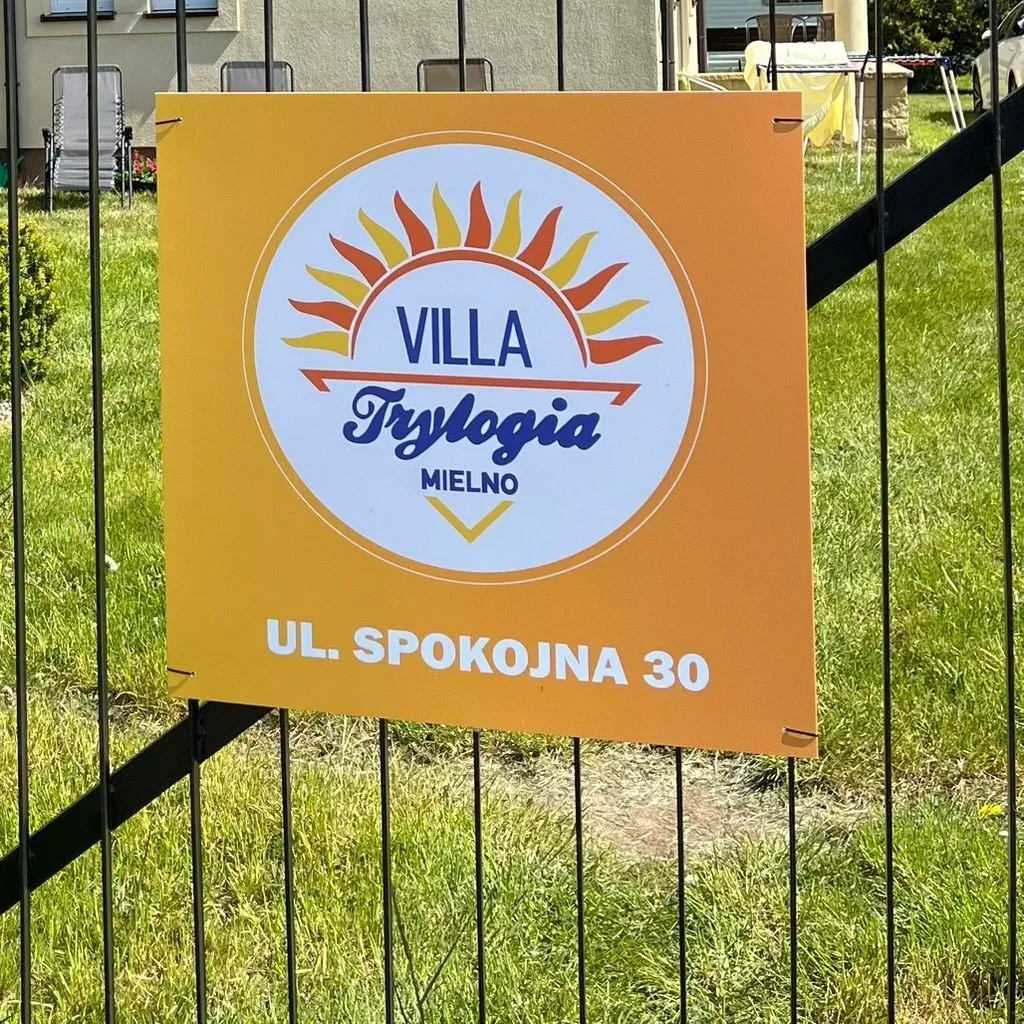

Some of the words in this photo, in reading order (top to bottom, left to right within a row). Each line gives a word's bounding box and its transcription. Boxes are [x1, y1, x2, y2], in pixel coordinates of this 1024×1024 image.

[396, 305, 532, 368] VILLA
[343, 385, 601, 466] Trylogia
[420, 467, 519, 496] MIELNO
[266, 618, 338, 659] UL.
[352, 626, 629, 686] SPOKOJNA
[643, 651, 710, 692] 30
